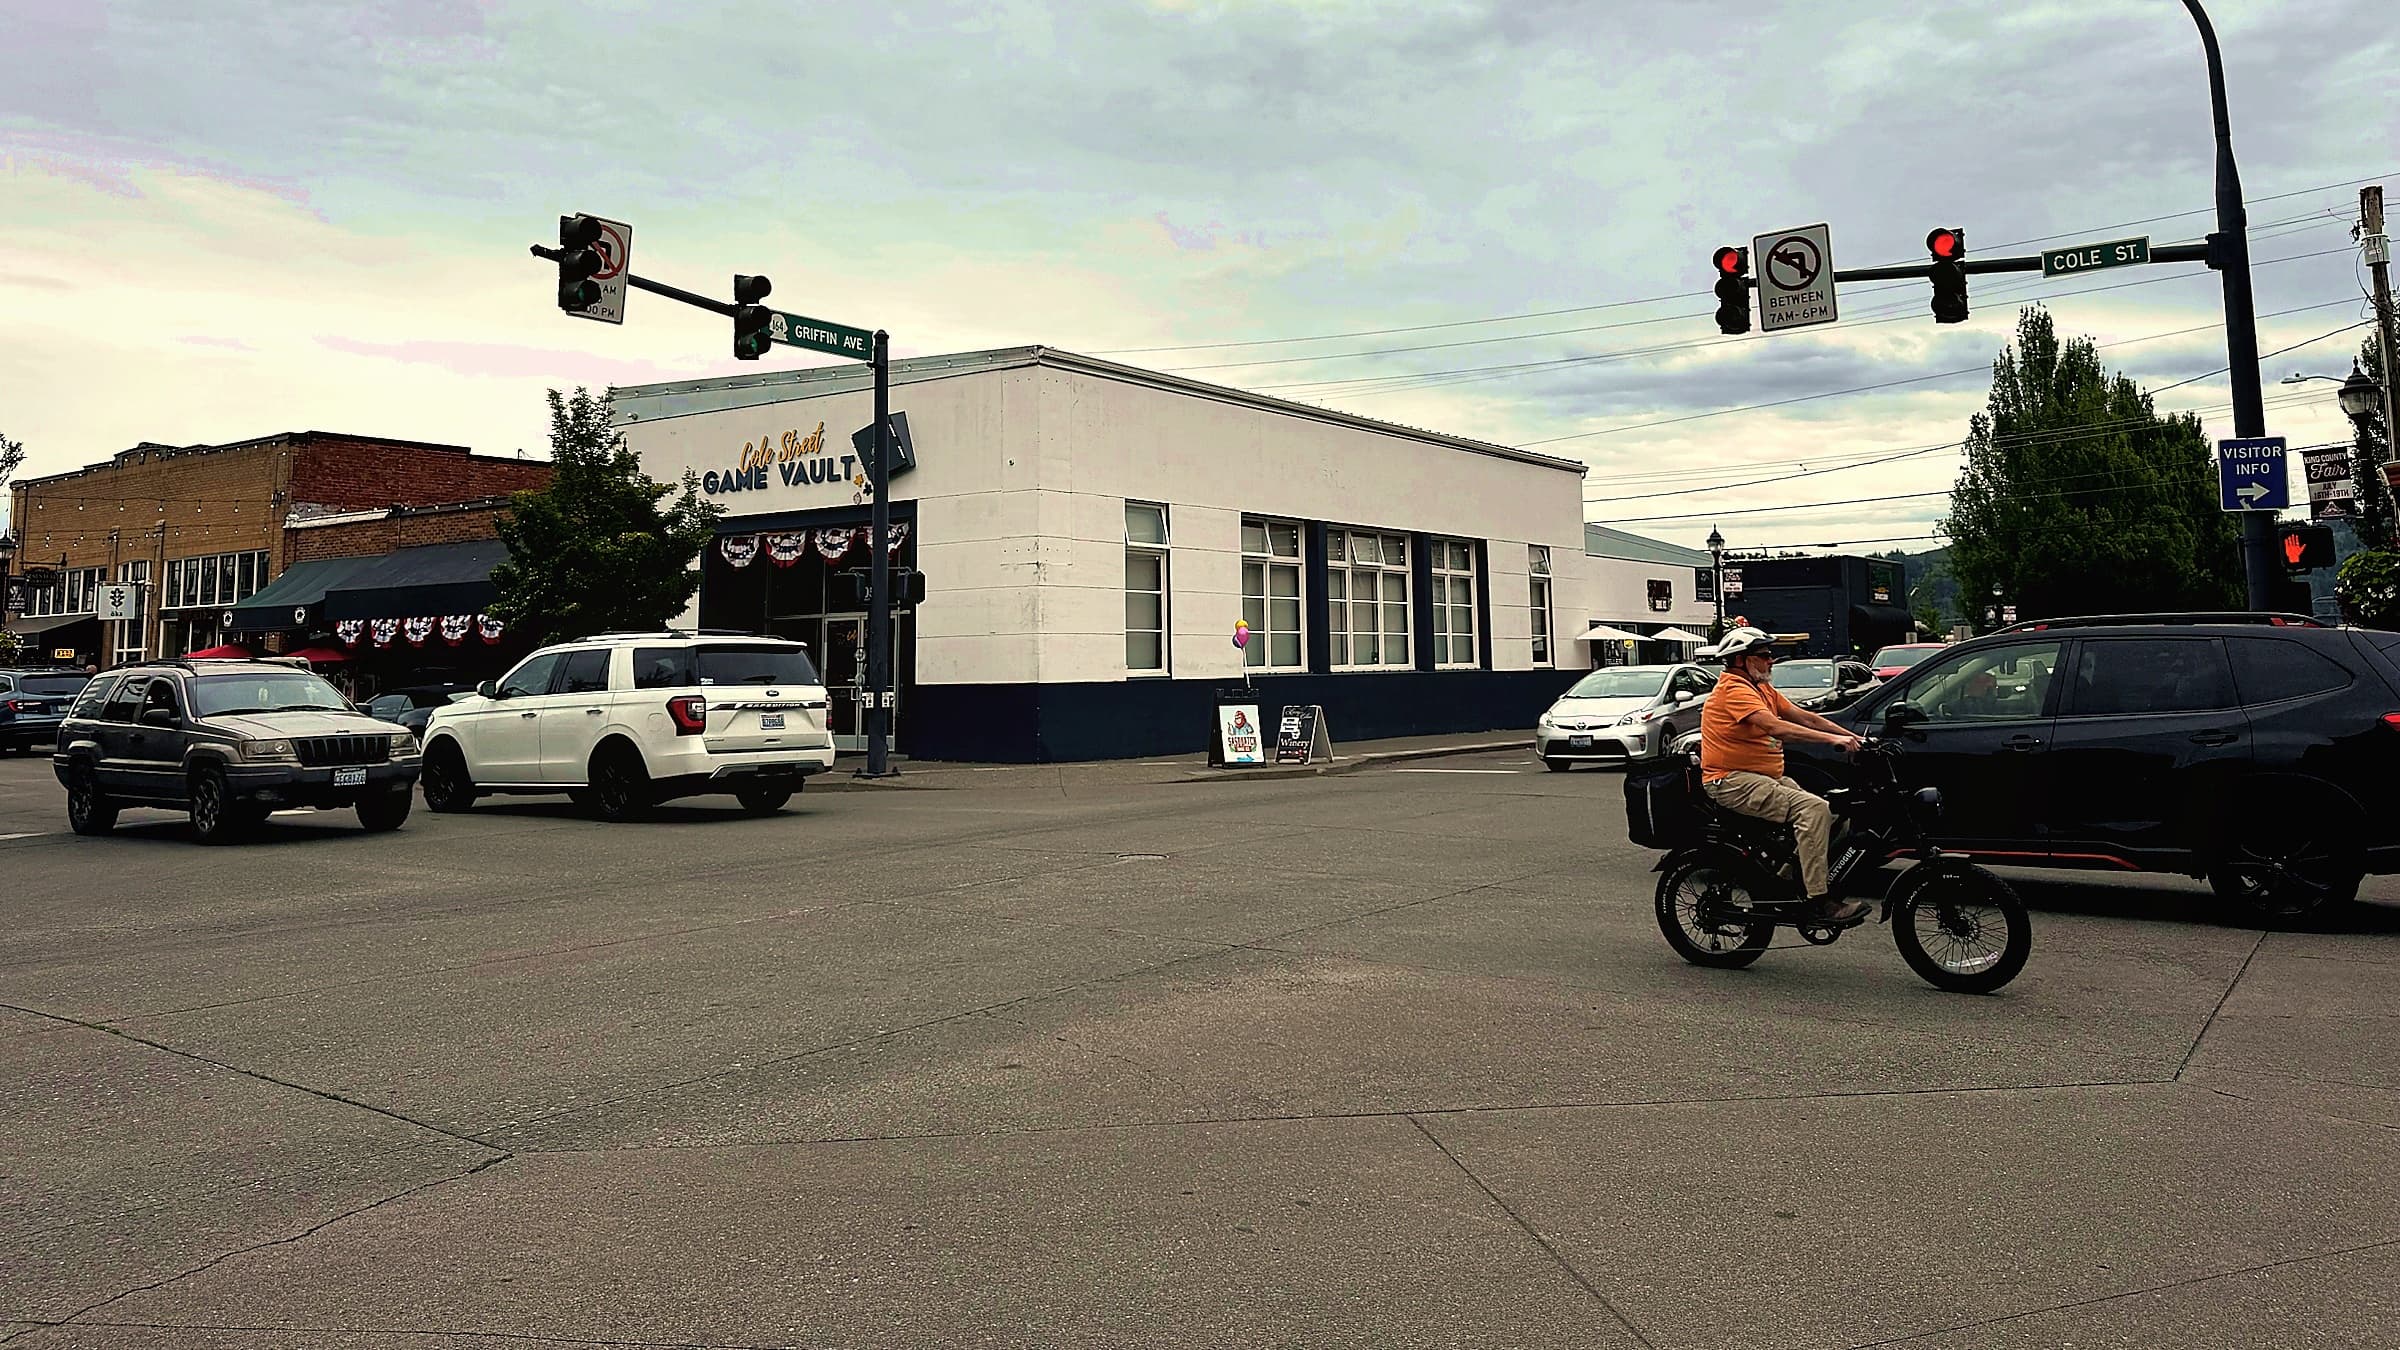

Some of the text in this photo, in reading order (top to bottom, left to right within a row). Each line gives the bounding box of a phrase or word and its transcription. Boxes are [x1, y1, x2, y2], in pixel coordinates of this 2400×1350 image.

[2053, 244, 2140, 270] COLE ST.
[602, 284, 617, 295] AM
[1769, 291, 1824, 308] BETWEEN
[601, 307, 615, 318] PM
[795, 324, 866, 352] GRIFFIN AVE.
[740, 420, 824, 473] Cole Street
[2223, 445, 2282, 460] VISITOR
[2321, 452, 2347, 462] COUNTY
[703, 455, 855, 495] GAME VAULT
[2236, 463, 2270, 475] INFO
[2310, 462, 2347, 480] Fair
[1280, 738, 1310, 750] Winery
[1827, 846, 1857, 885] OLTVOGUE
